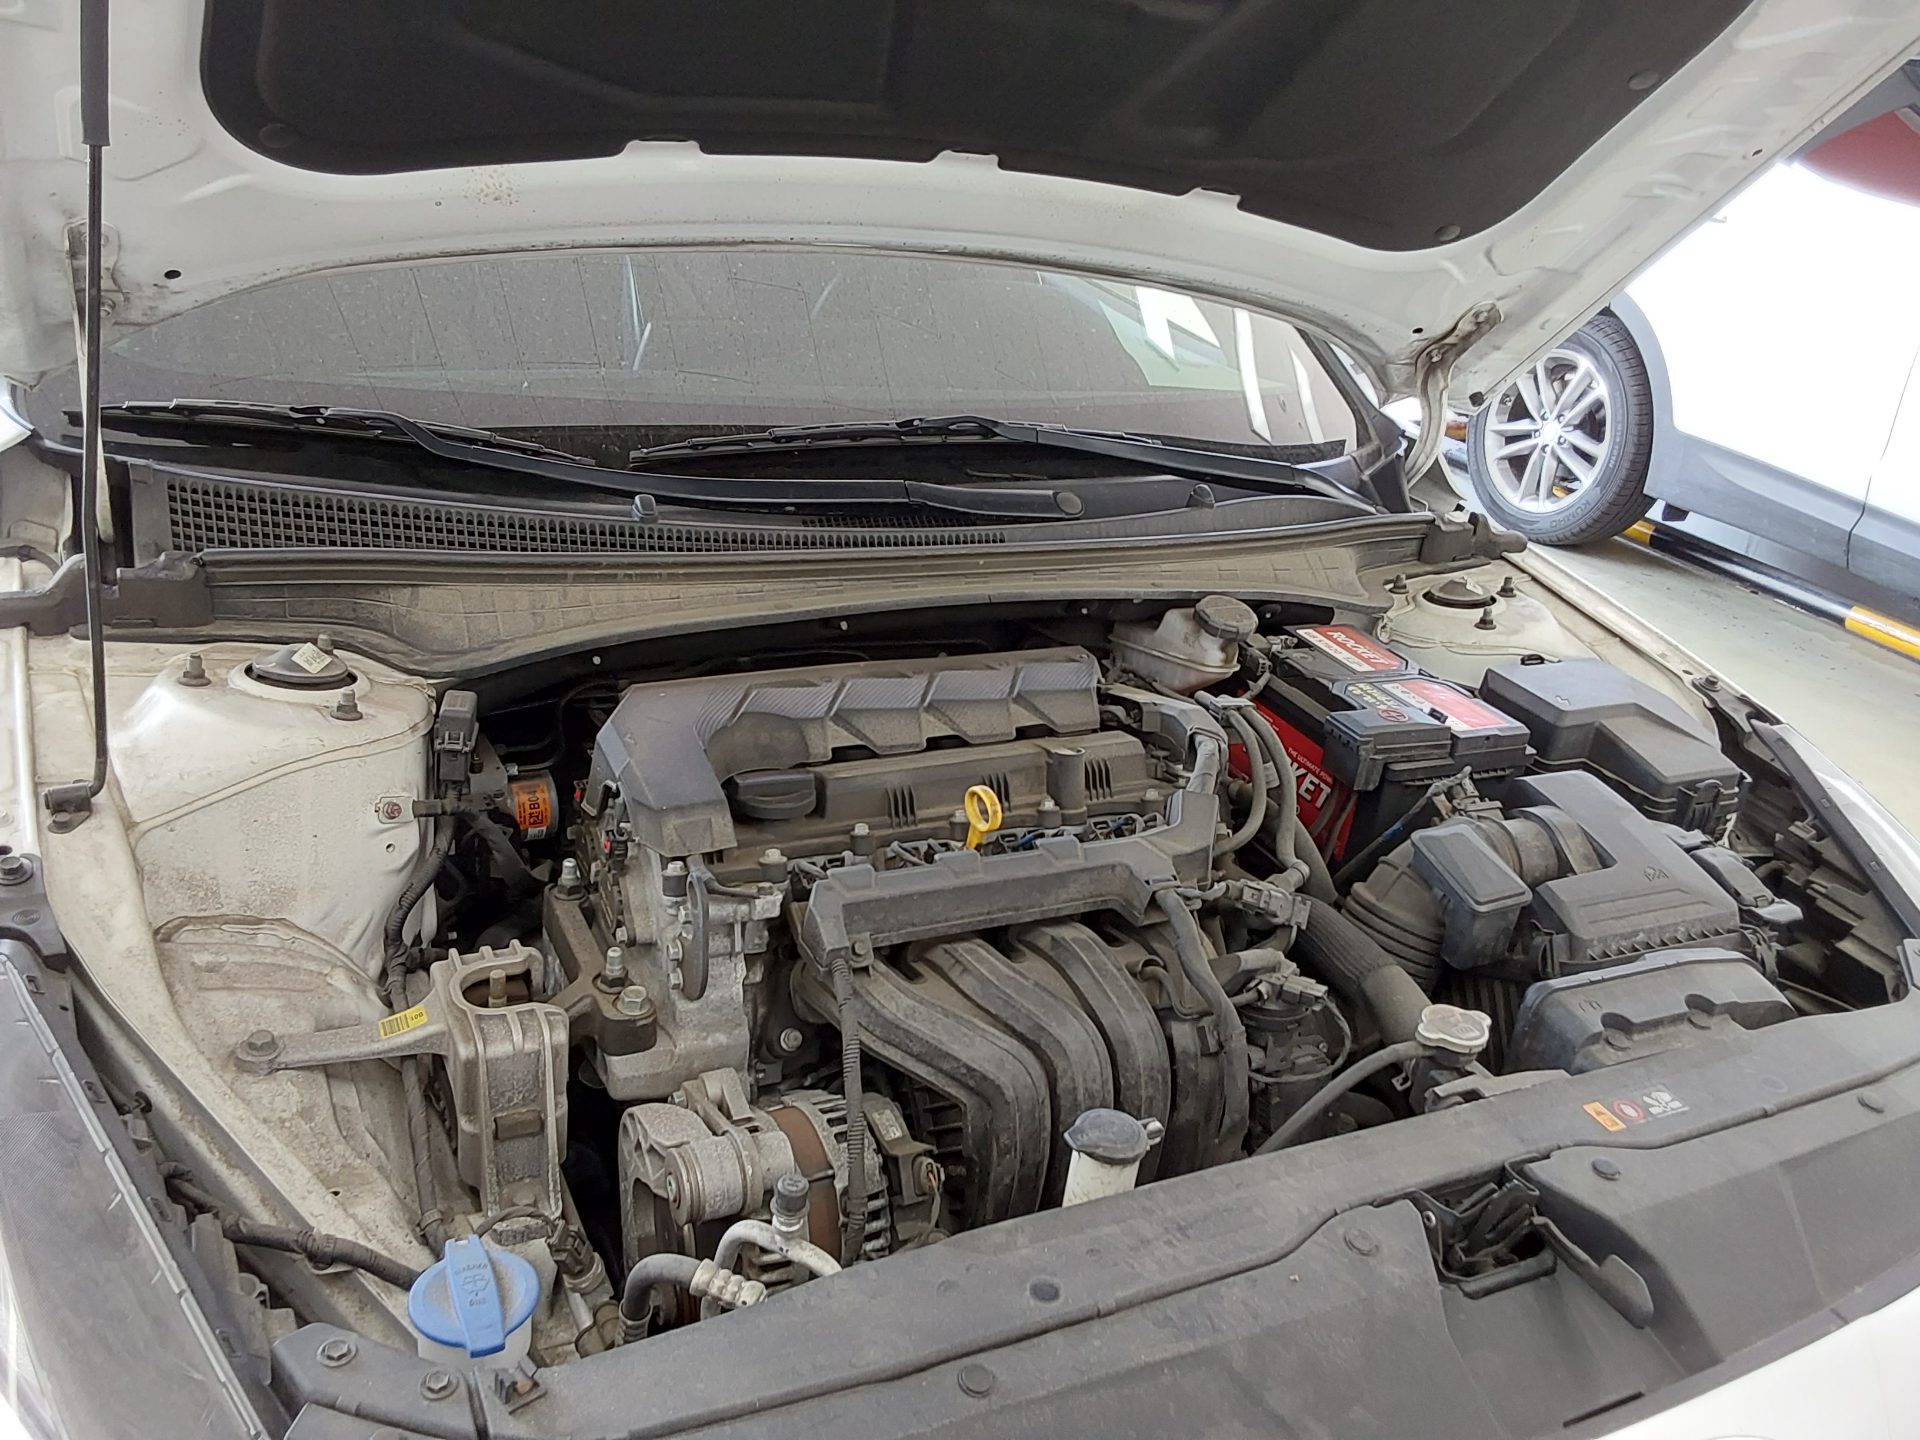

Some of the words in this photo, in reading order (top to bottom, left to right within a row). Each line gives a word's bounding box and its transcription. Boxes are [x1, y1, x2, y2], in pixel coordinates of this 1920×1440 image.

[1550, 499, 1592, 528] KUMHO
[1326, 631, 1390, 665] ROCKET
[1290, 761, 1332, 809] KET
